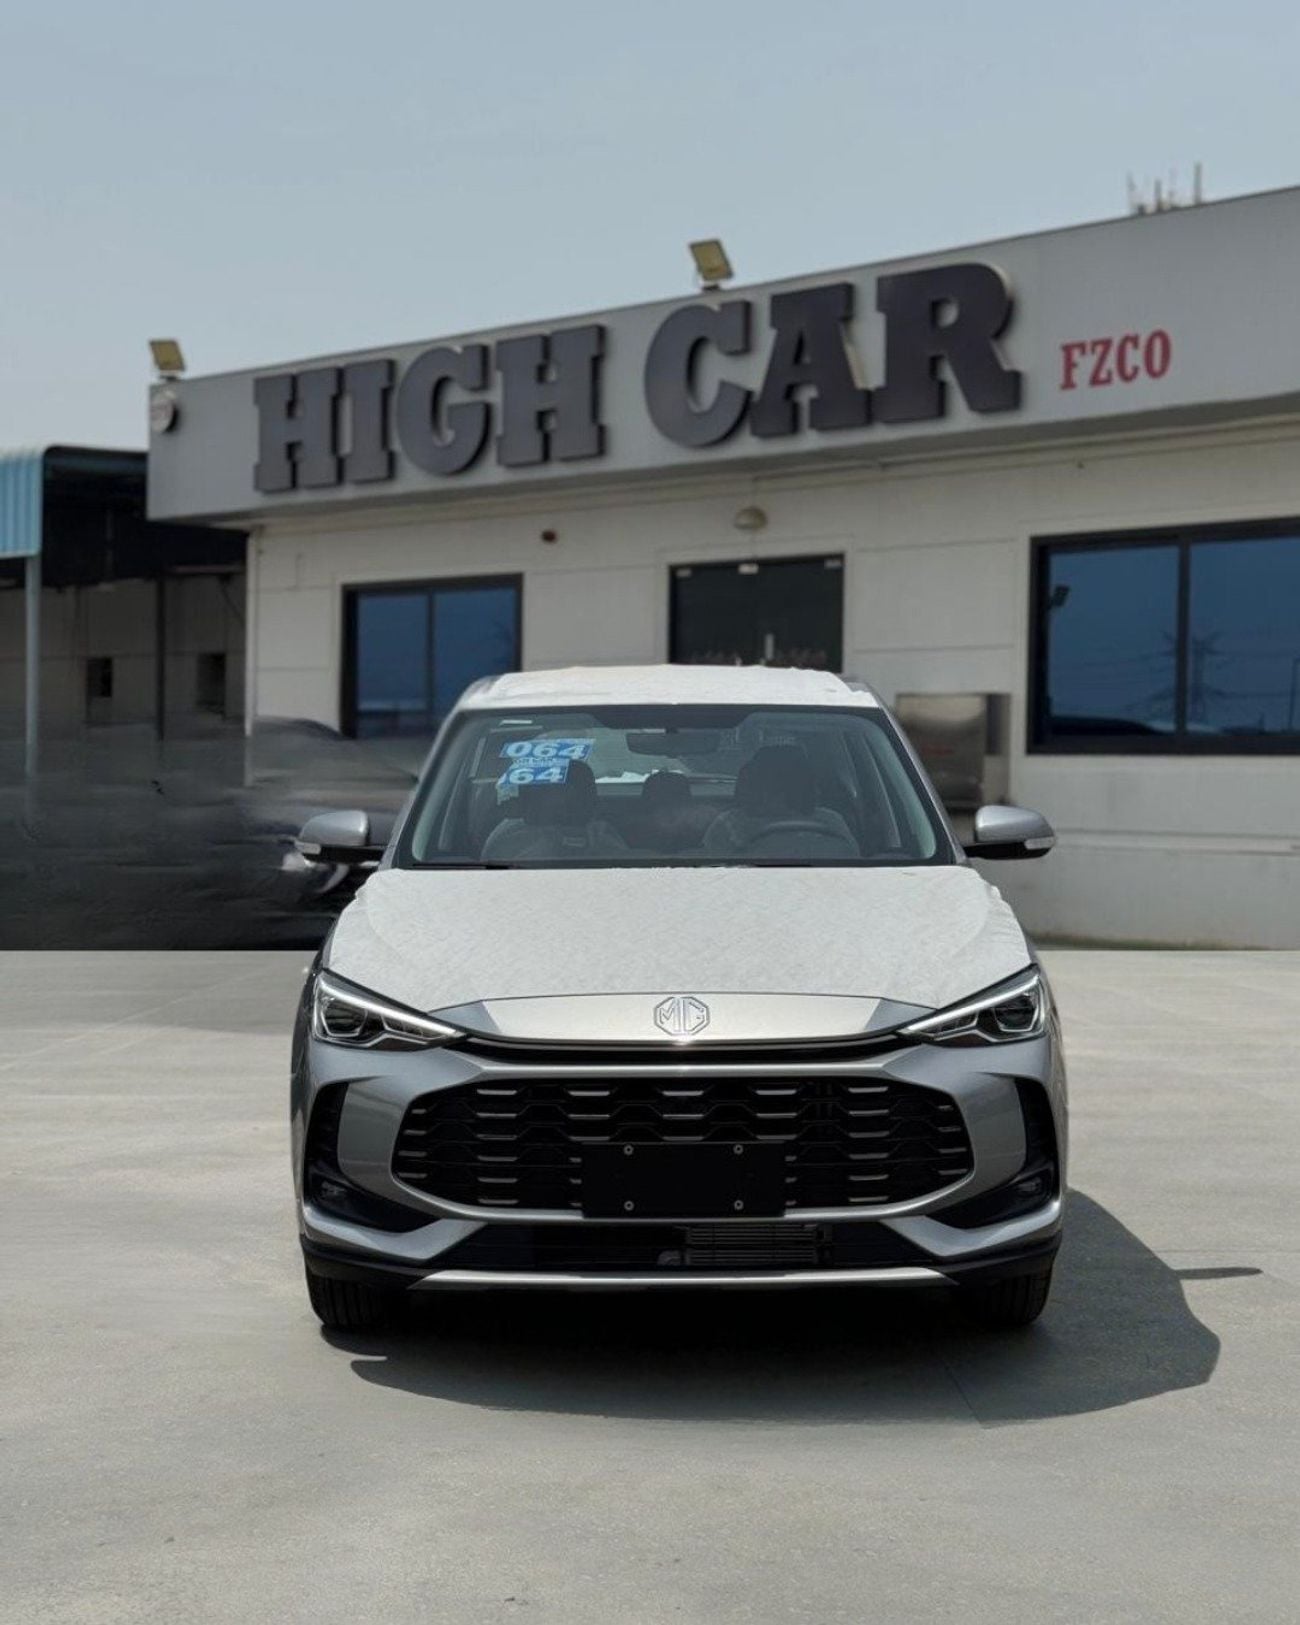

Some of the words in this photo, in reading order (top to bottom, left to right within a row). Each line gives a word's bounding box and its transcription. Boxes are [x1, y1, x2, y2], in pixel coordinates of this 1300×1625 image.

[254, 325, 606, 494] HIGH
[644, 262, 1022, 448] CAR
[1060, 330, 1171, 391] FZCO
[506, 741, 586, 760] 064
[656, 997, 708, 1034] MG
